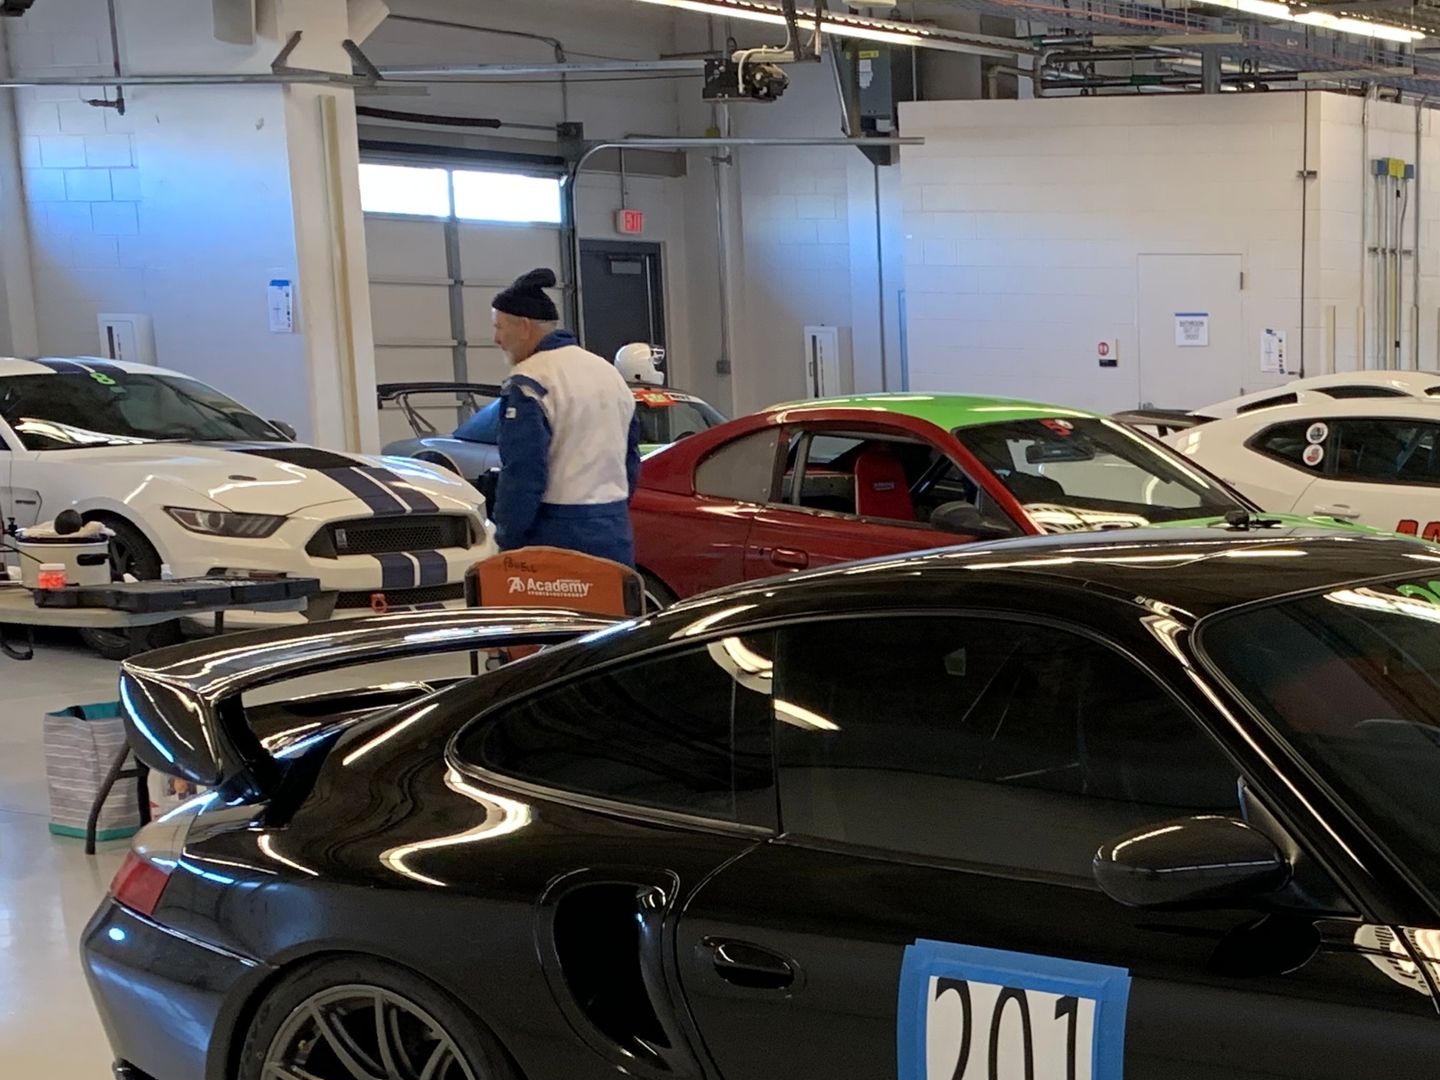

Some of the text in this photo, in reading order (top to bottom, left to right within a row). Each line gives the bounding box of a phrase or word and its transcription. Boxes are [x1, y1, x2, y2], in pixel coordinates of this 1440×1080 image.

[624, 211, 642, 232] EXIT
[90, 372, 115, 385] 8
[527, 578, 590, 596] Academy
